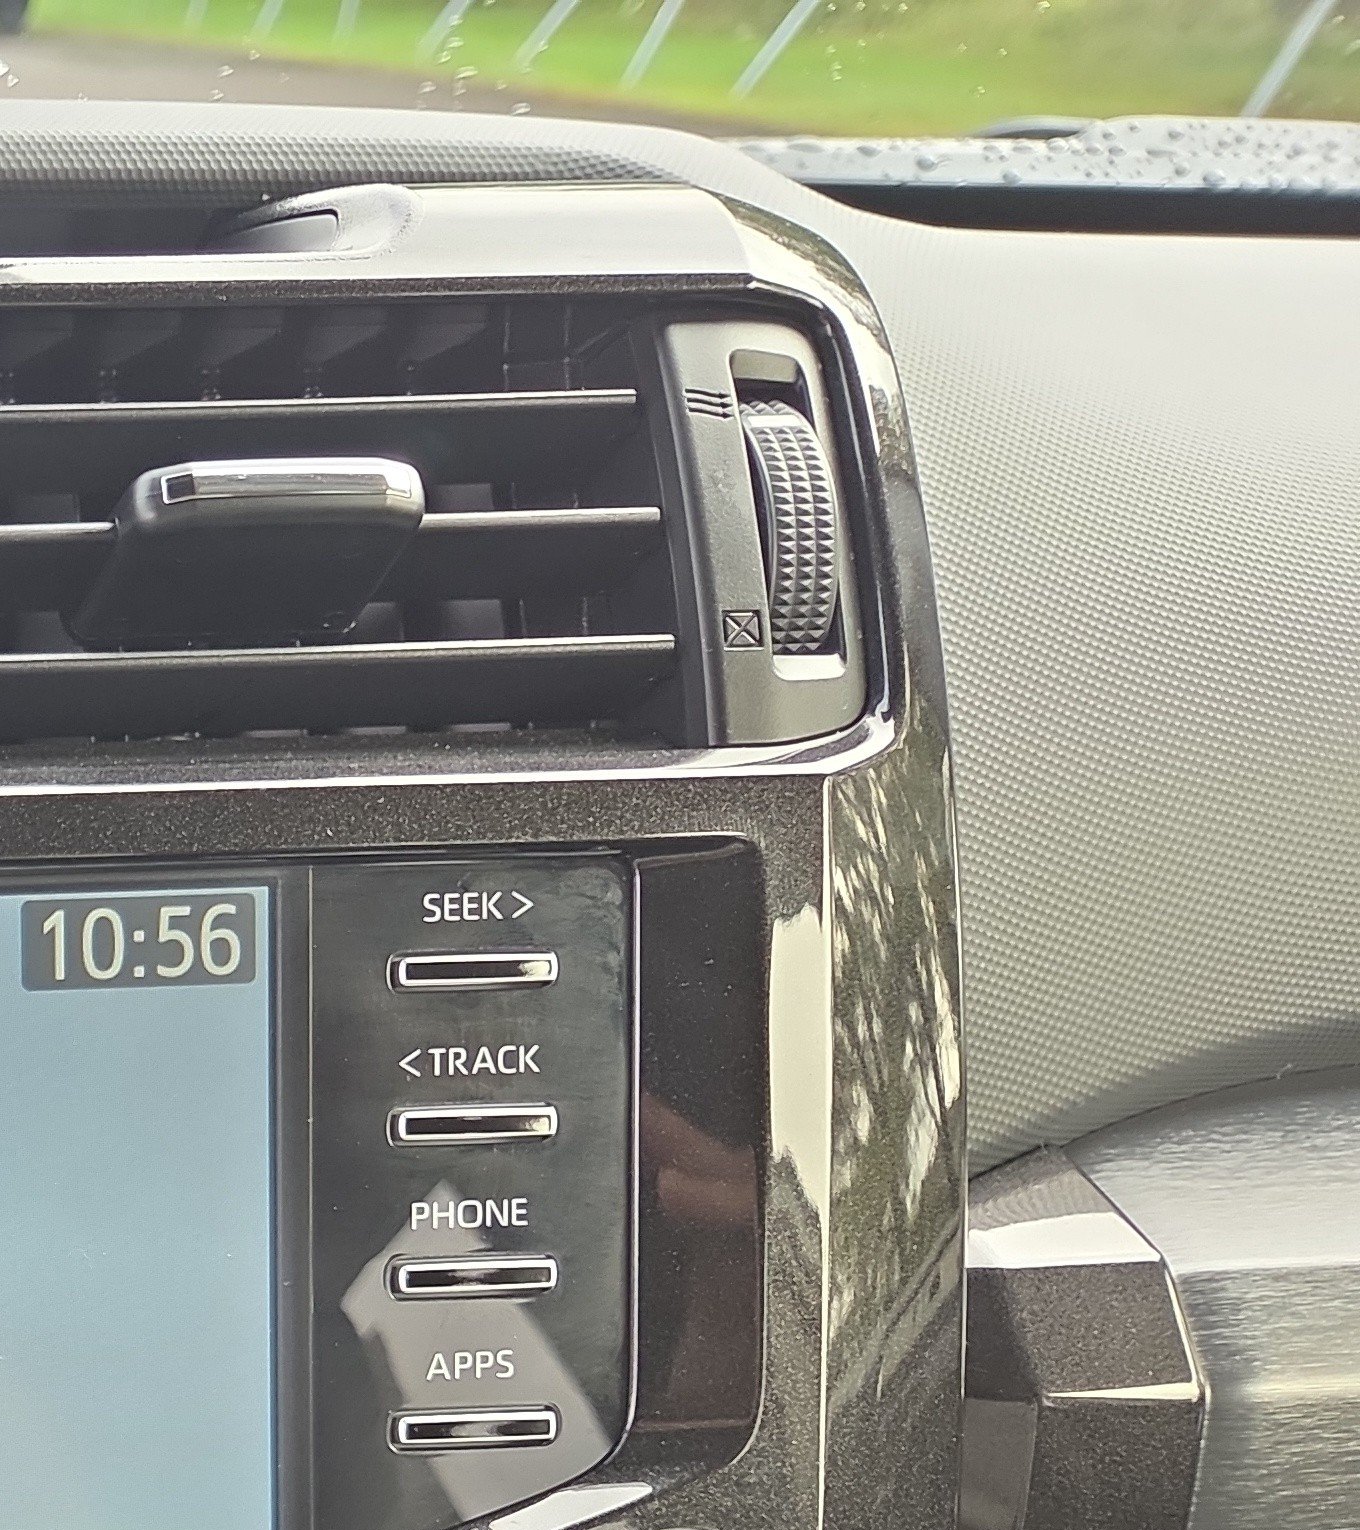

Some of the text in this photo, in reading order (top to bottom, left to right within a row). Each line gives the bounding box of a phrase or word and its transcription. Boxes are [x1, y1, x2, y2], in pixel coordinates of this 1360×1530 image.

[40, 902, 242, 982] 10:56
[409, 1197, 529, 1230] PHONE
[425, 1350, 515, 1382] APPS
